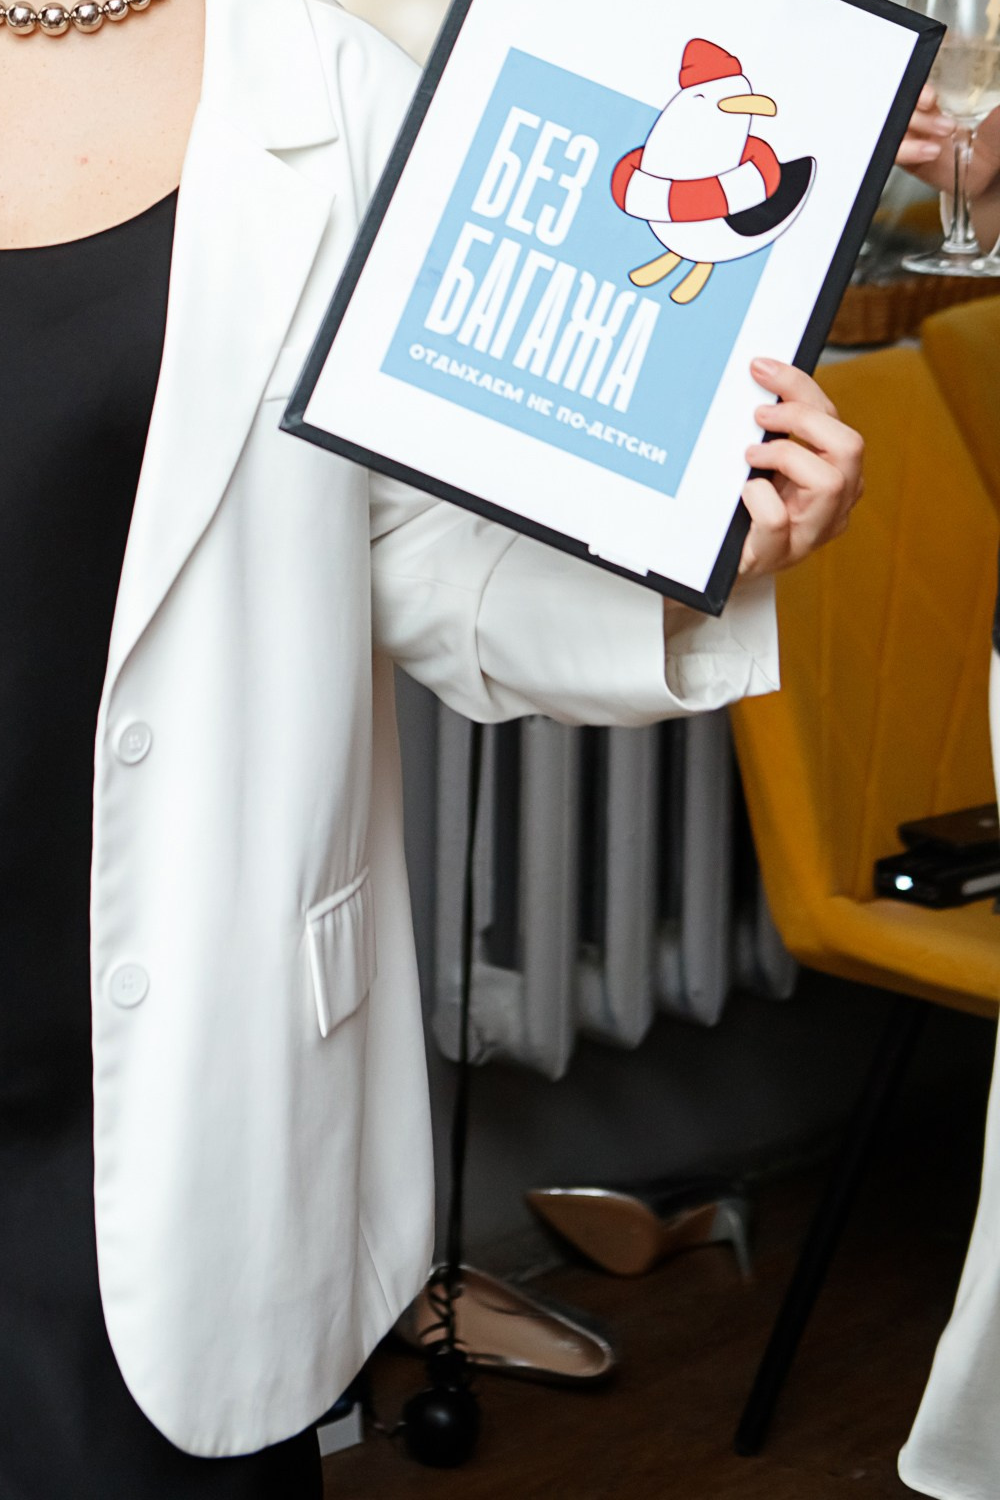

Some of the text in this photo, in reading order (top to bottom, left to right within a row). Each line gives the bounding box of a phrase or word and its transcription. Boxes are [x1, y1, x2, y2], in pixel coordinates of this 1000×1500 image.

[471, 106, 600, 247] БЕЗ
[424, 221, 662, 414] БАГАЖА
[408, 343, 669, 466] ОТДЫХАЕМ НЕ ПО-ДЕТСКИ
